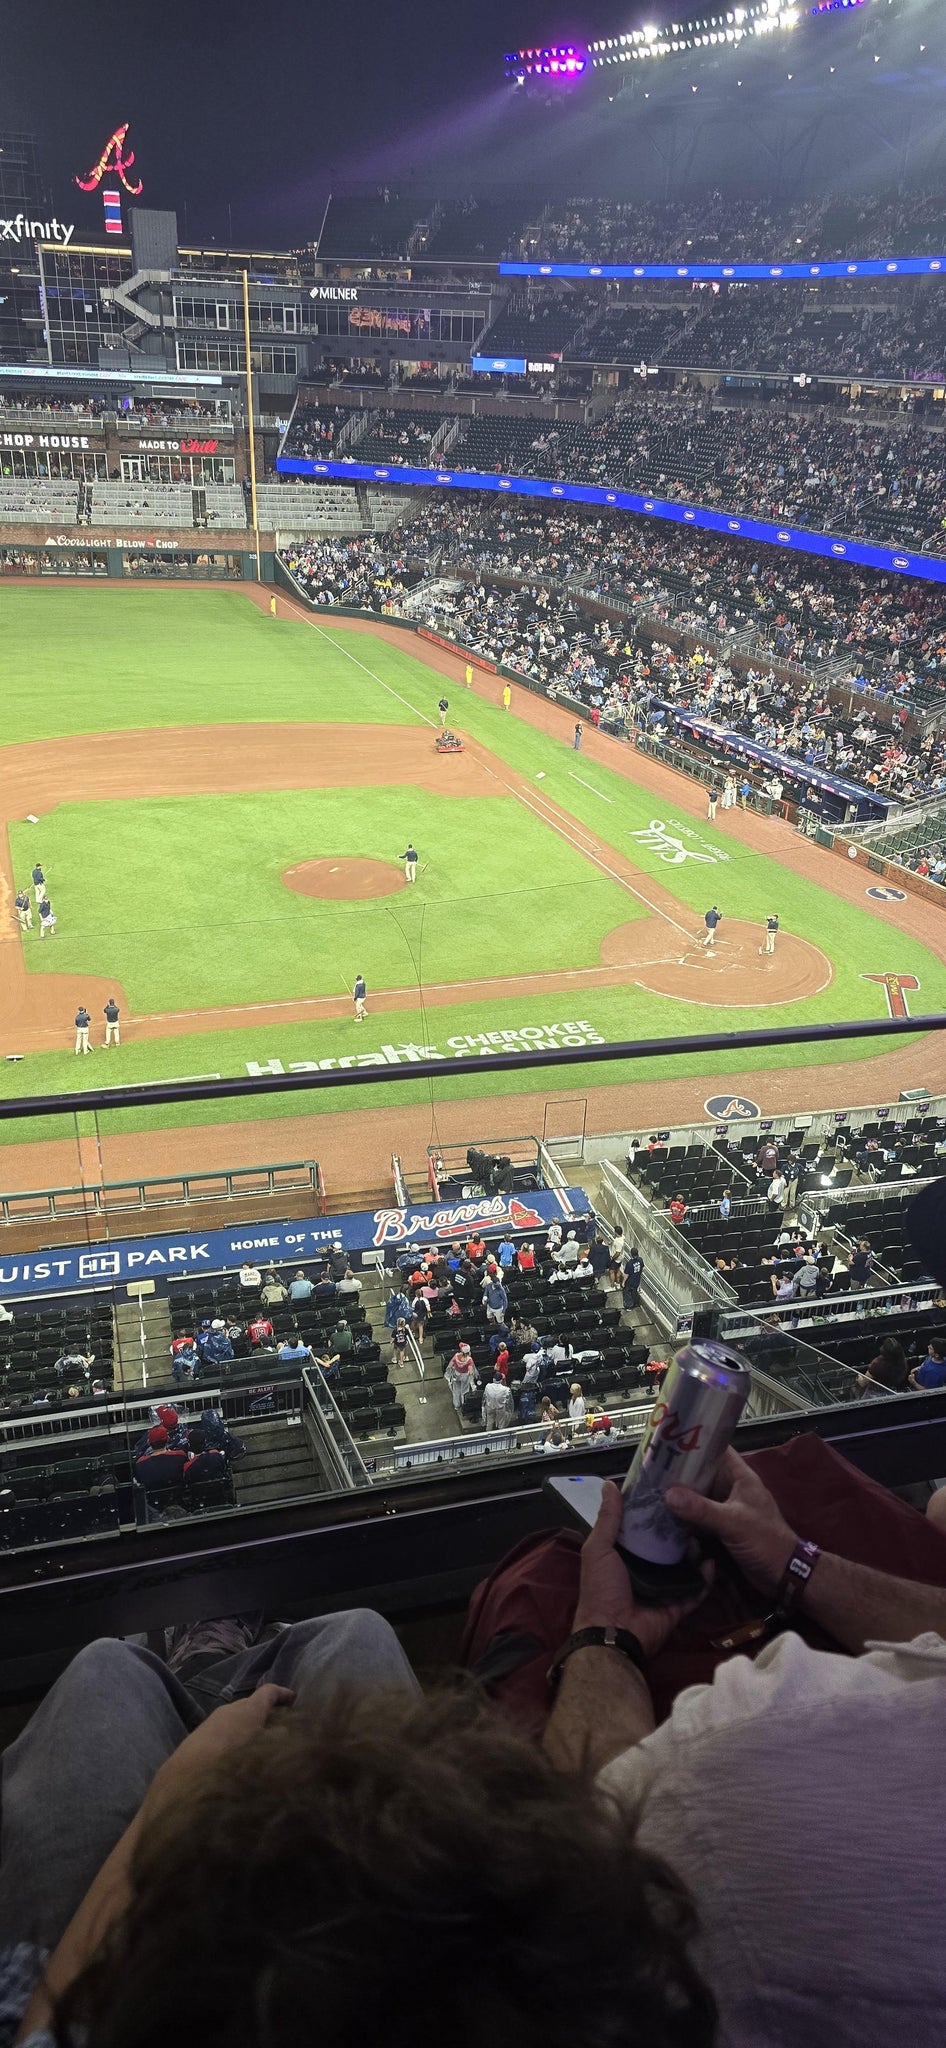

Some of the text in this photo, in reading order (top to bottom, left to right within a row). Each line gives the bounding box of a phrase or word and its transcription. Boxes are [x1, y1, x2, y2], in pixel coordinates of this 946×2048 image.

[0, 214, 74, 246] xfinity
[320, 287, 357, 300] MILNER
[0, 434, 89, 448] HOP HOUSE
[139, 438, 218, 453] MADE TO Chill
[57, 535, 85, 546] Coors
[86, 539, 111, 547] LIGHT
[116, 538, 145, 548] BELOW
[156, 540, 178, 548] CHOP
[446, 1020, 595, 1049] CHEROKEE
[372, 1195, 507, 1246] Braves
[230, 1229, 343, 1251] HOME OF THE
[127, 1243, 210, 1267] PARK
